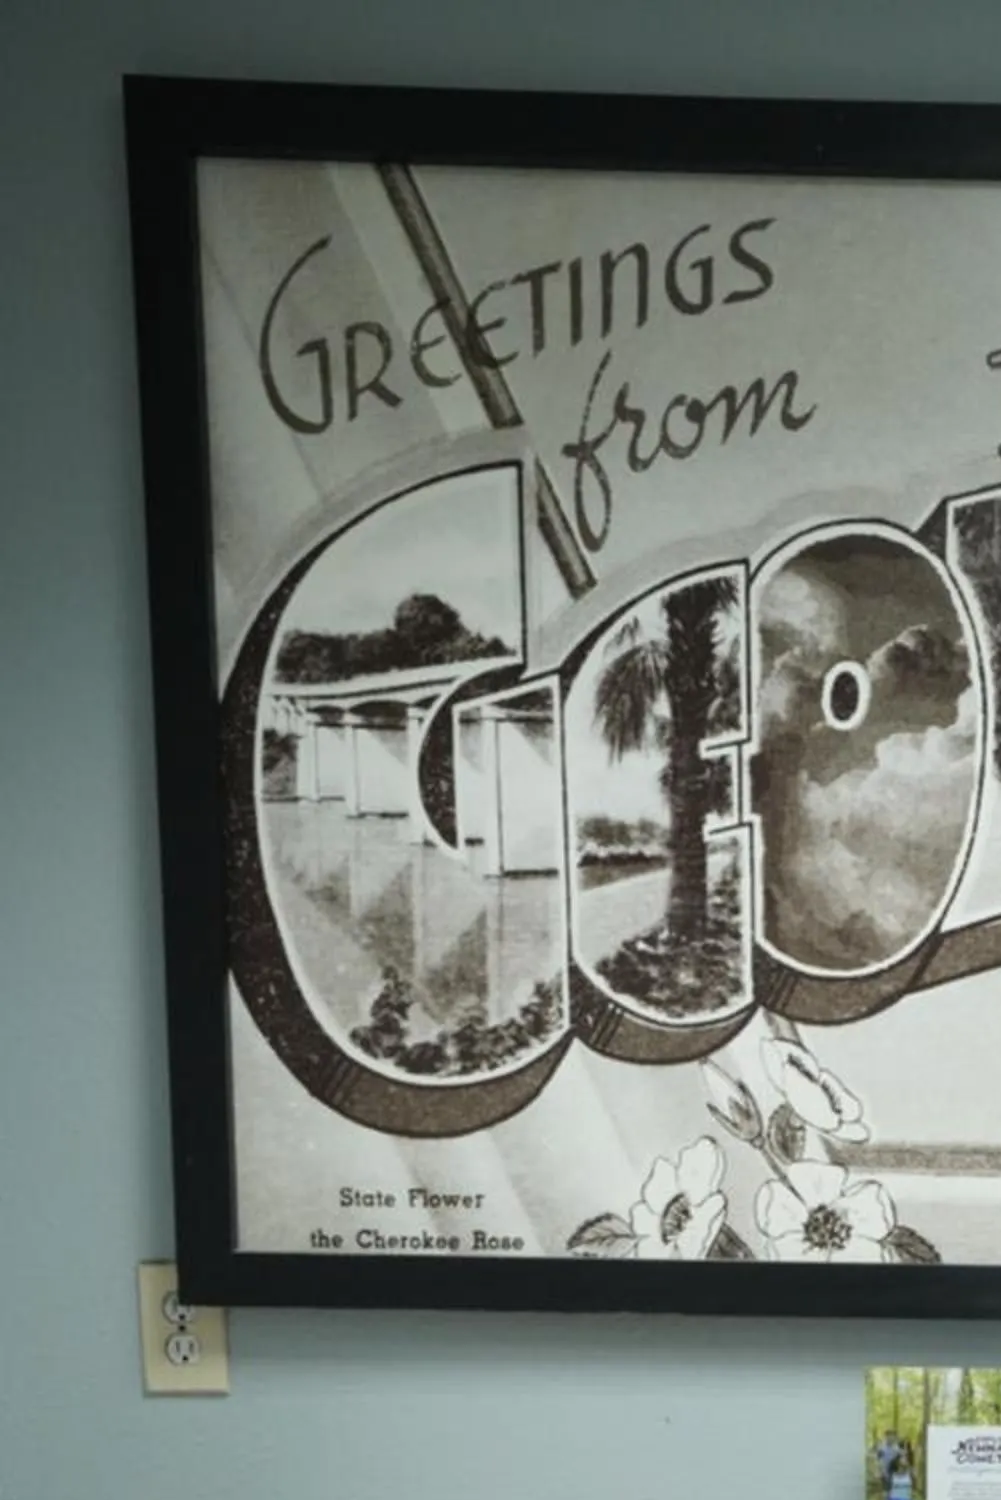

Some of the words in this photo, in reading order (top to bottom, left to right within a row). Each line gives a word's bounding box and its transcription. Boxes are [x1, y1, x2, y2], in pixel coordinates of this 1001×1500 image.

[561, 350, 818, 553] from
[339, 1187, 396, 1208] State
[407, 1188, 485, 1209] Flower
[310, 1228, 344, 1249] the
[355, 1229, 461, 1250] Cherokee
[471, 1230, 525, 1251] Rose
